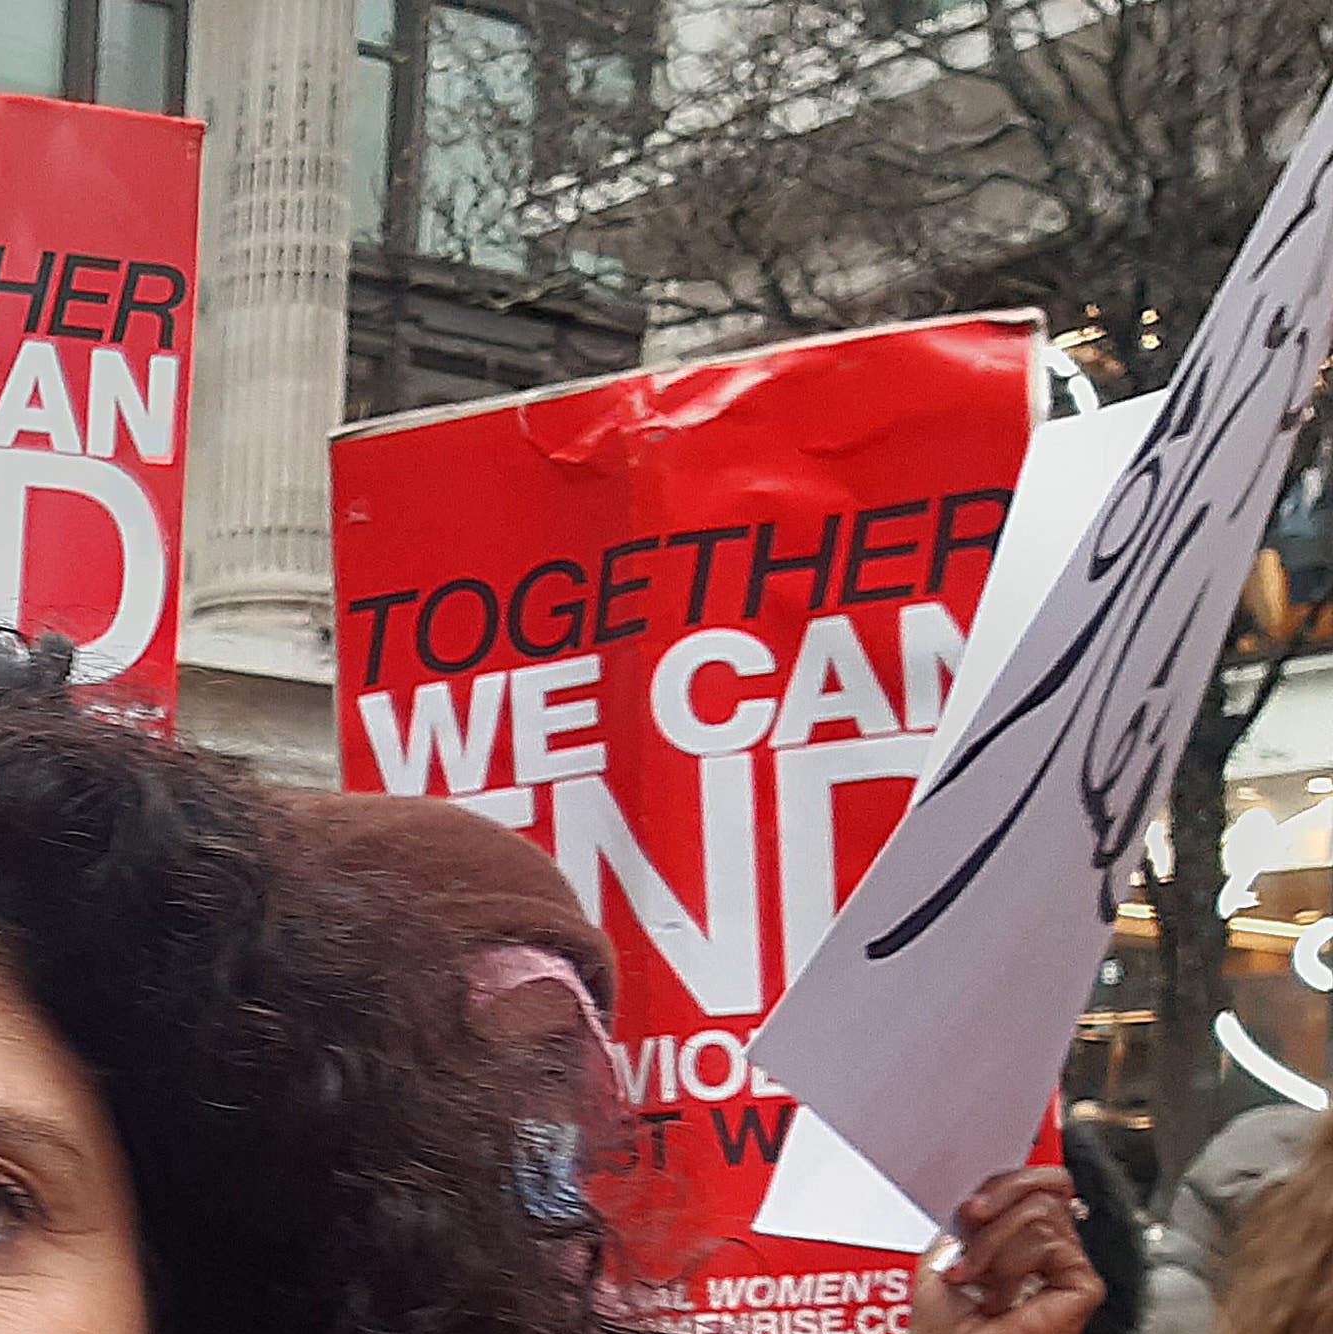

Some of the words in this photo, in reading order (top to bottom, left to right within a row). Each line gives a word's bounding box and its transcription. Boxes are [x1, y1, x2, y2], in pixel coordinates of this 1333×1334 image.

[349, 488, 1015, 686] TOGETHER
[357, 654, 608, 797] WE
[706, 1268, 911, 1309] WOMEN'S
